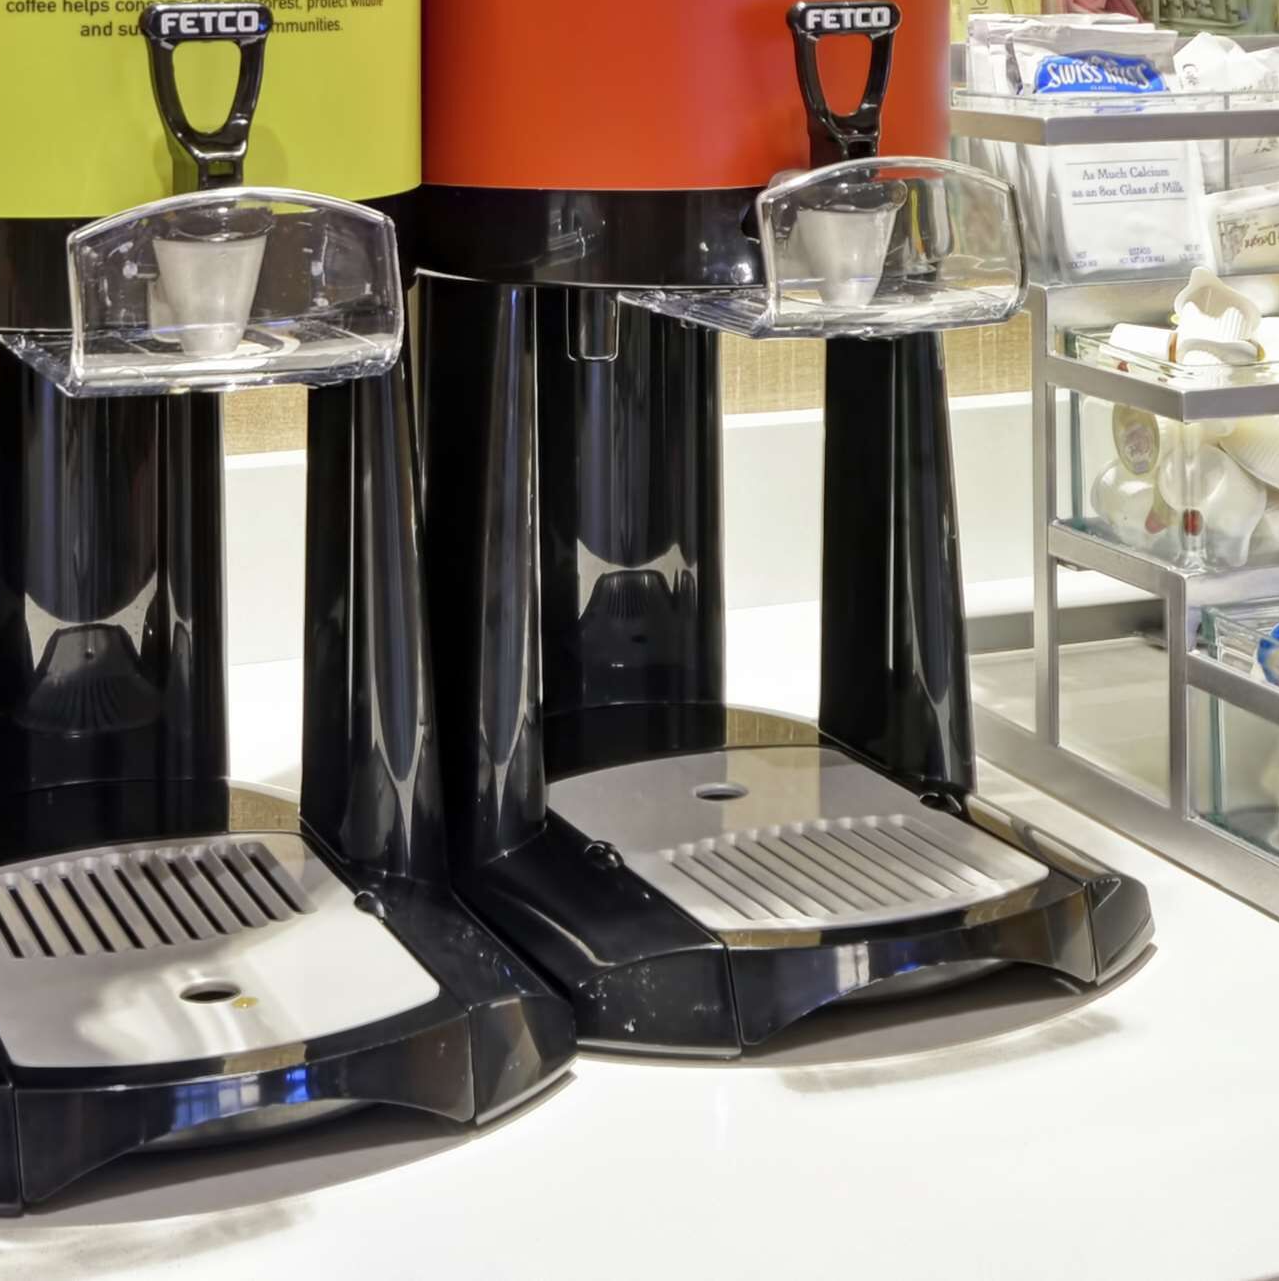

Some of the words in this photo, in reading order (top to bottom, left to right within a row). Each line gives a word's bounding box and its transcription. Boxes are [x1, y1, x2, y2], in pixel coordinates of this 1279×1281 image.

[160, 10, 260, 35] FETCO
[805, 7, 890, 29] FETCO
[80, 21, 113, 37] and
[1082, 170, 1094, 180] As
[1098, 168, 1127, 179] Much
[1129, 166, 1170, 178] Calcium
[1120, 184, 1147, 196] Glass
[1149, 182, 1160, 194] of
[1162, 180, 1185, 193] Milk
